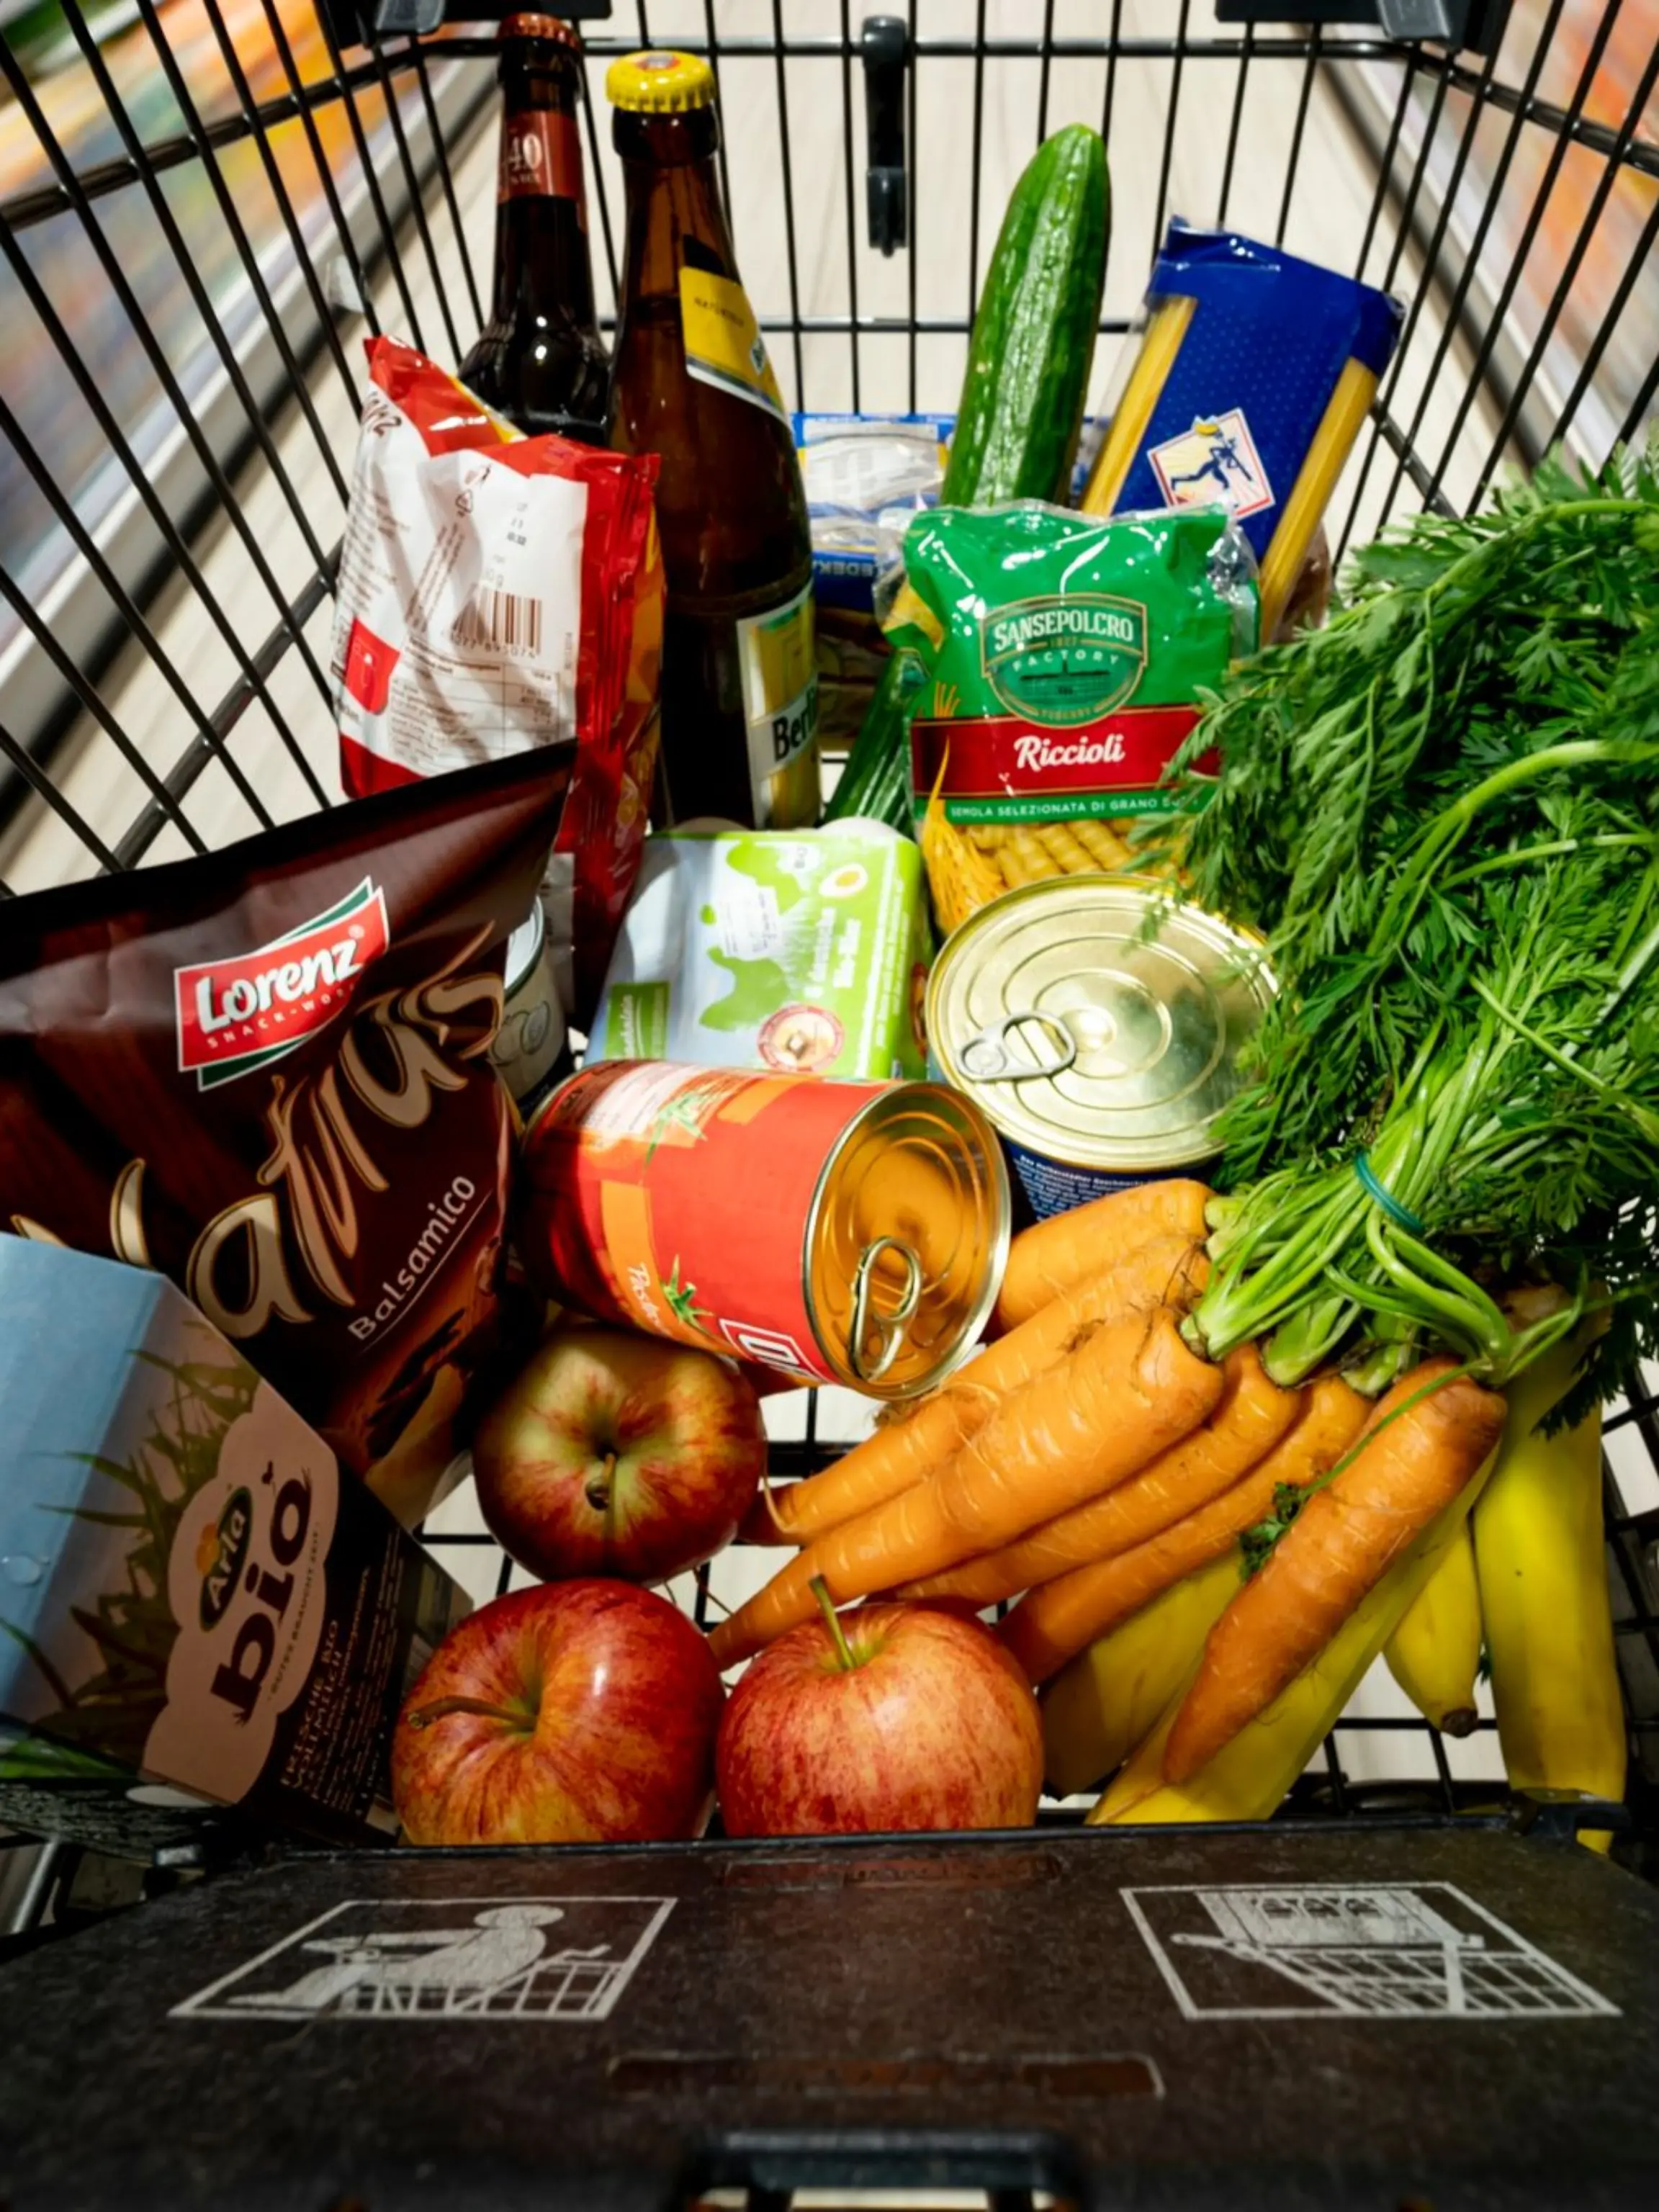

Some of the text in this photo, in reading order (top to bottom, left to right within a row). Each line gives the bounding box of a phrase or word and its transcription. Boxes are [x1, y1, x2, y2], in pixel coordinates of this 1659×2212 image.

[994, 610, 1134, 652] SANSEPOLCRO
[1012, 649, 1119, 671] FACTORY
[1013, 733, 1126, 773] Riccioli
[997, 803, 1086, 817] SELEZIONATA
[1092, 801, 1105, 812] DI
[1110, 799, 1158, 811] GRANO
[195, 938, 364, 1035] Lorenz
[347, 1175, 475, 1341] Balsamico
[208, 1510, 246, 1610] Arla
[210, 1475, 313, 1726] bio
[320, 1619, 339, 1665] BIO
